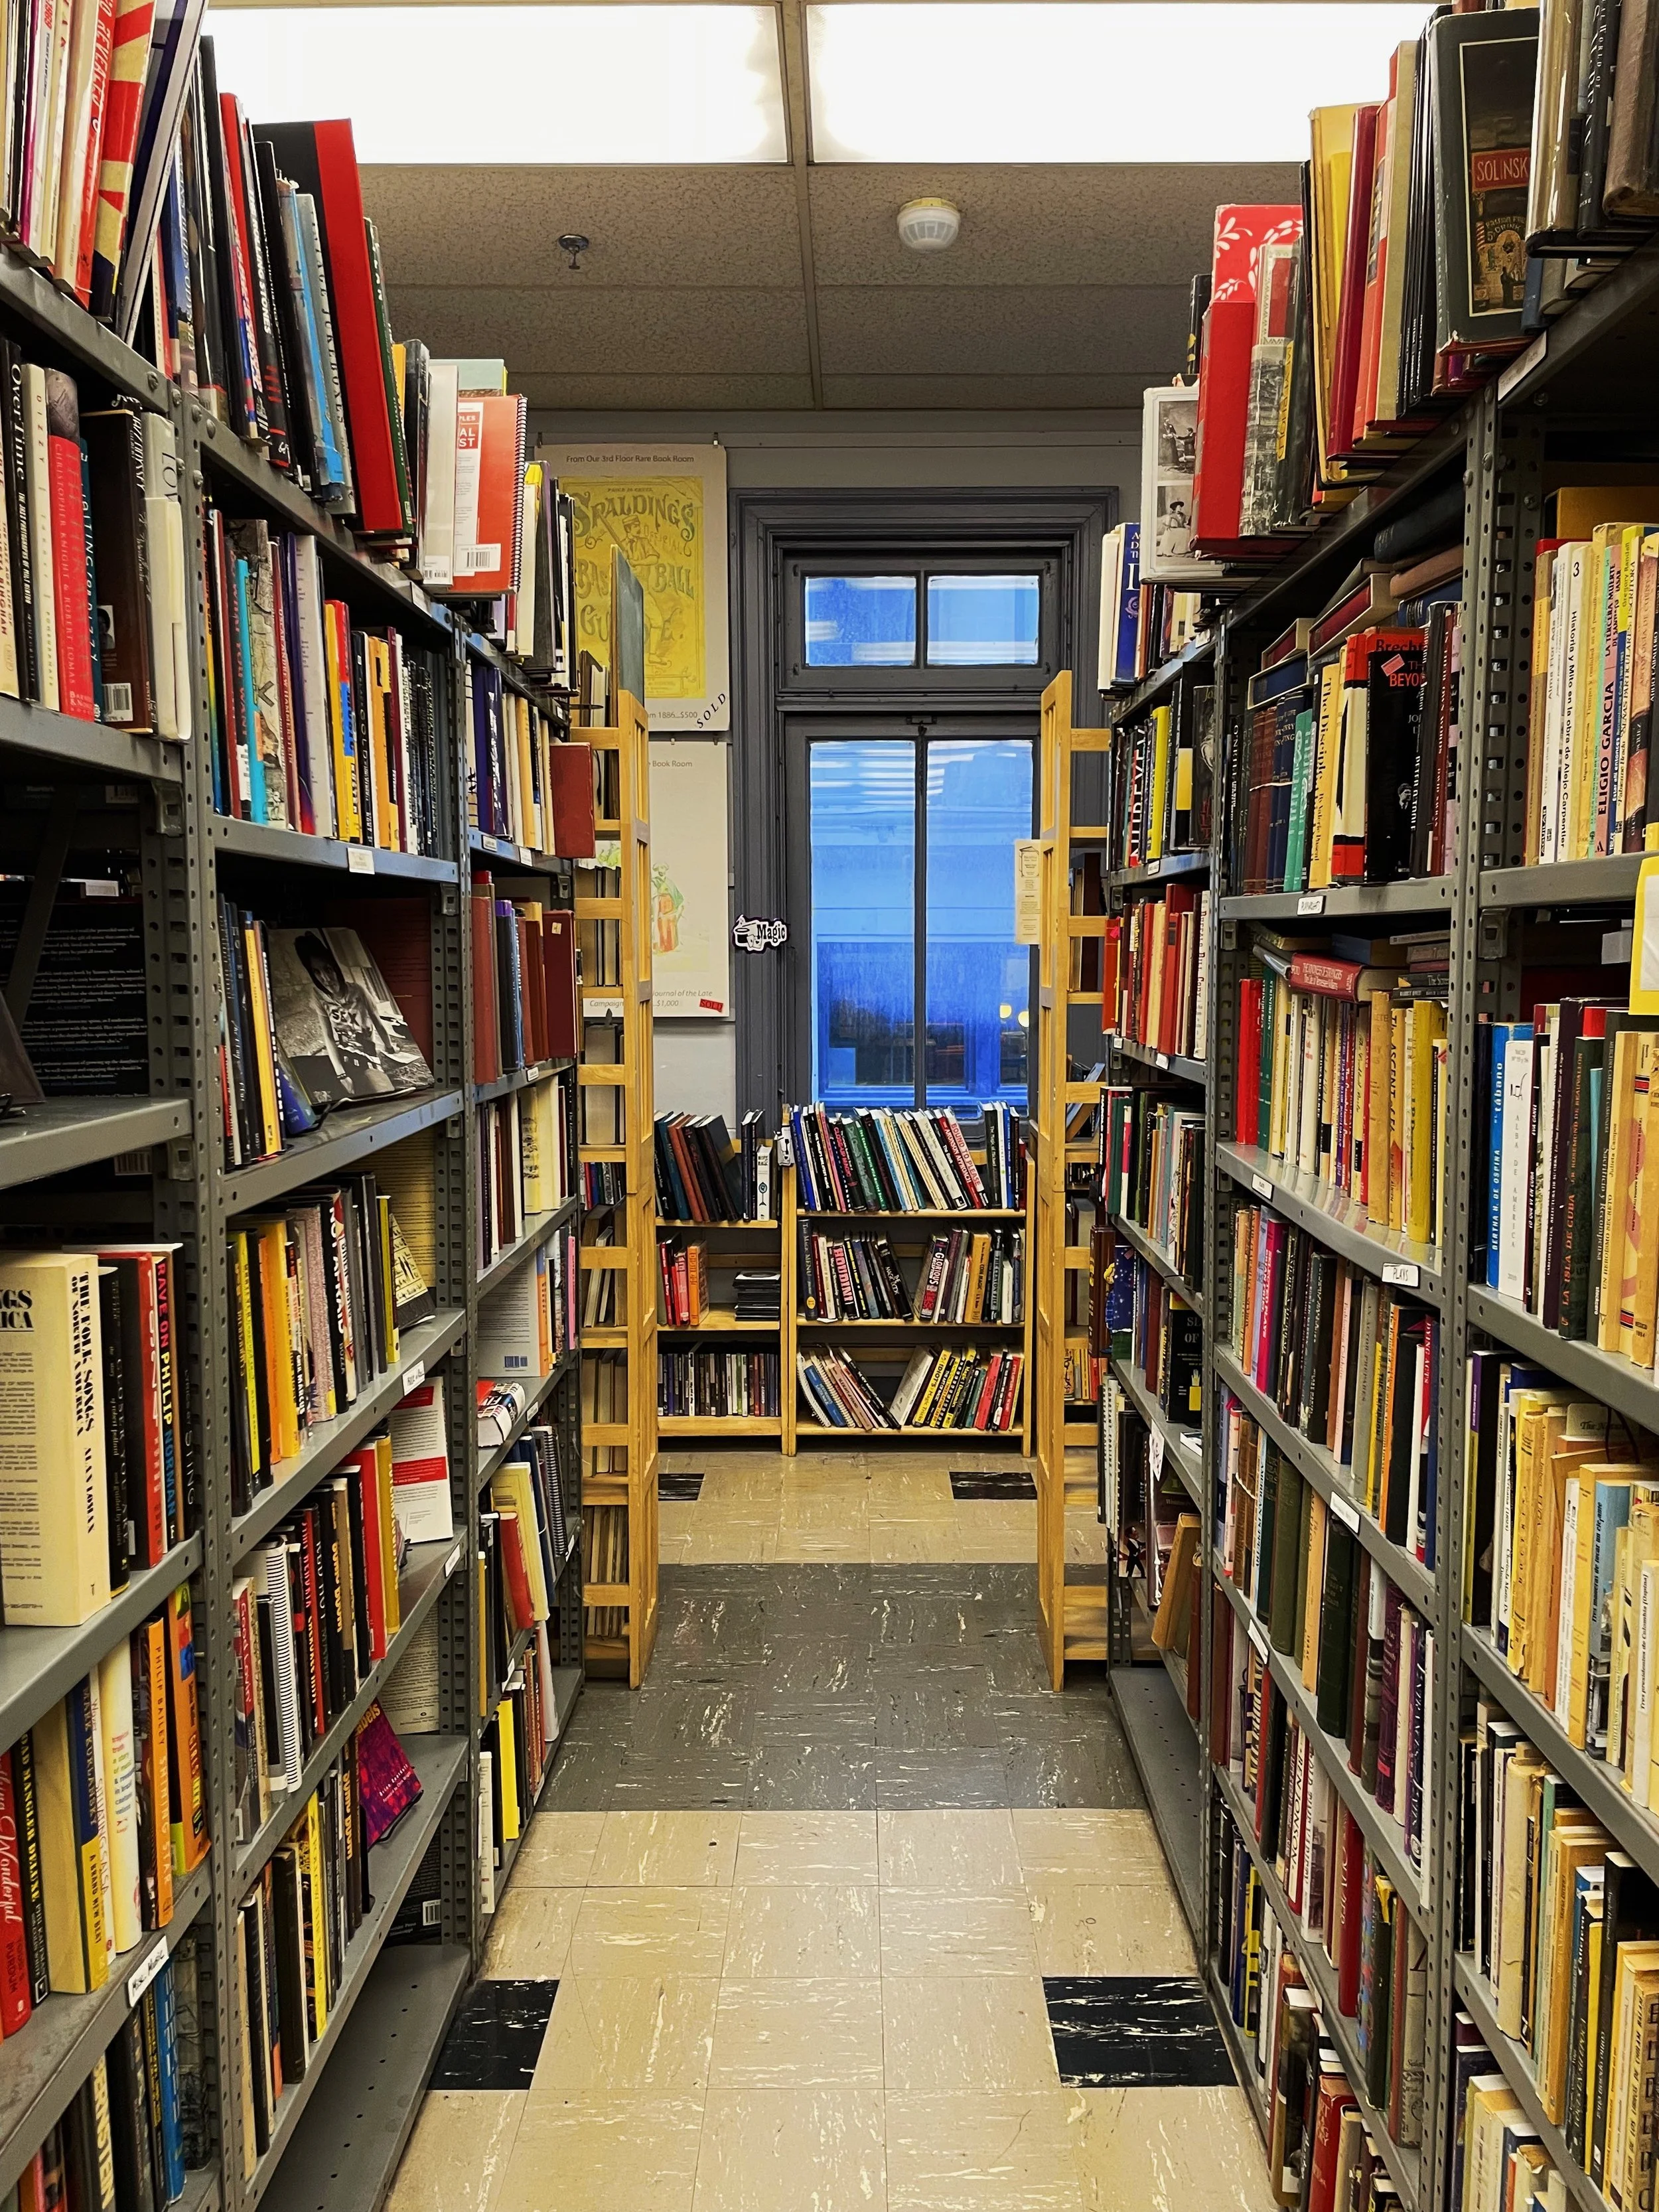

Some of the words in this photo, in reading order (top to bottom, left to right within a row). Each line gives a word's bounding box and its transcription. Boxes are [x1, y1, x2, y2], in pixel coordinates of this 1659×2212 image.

[1596, 25, 1607, 68] WORLD
[1595, 76, 1601, 89] OF
[1494, 223, 1520, 234] DRINK
[252, 220, 265, 279] ROLLING
[259, 281, 271, 334] STONES
[1277, 346, 1293, 461] MEYERHOLD
[54, 443, 66, 526] CHRISTOPHER
[61, 532, 70, 577] KNIGHT
[577, 557, 609, 599] BAS
[651, 563, 694, 601] BALL
[1571, 561, 1580, 577] 3
[1607, 562, 1616, 607] MUERTE
[1621, 575, 1630, 607] Gregory
[1569, 611, 1578, 650] Historia
[1605, 609, 1614, 644] TERCERA
[1605, 646, 1612, 656] LA
[696, 692, 727, 729] SOLD
[1322, 678, 1332, 712] The
[1566, 688, 1574, 701] en
[1564, 716, 1573, 739] obra
[1600, 681, 1615, 751] GARCIA
[1315, 715, 1329, 780] Disciple
[1563, 741, 1571, 755] de
[1561, 757, 1571, 790] Alejo
[1597, 756, 1611, 816] ELIGIO
[1559, 792, 1571, 848] Carpentier
[756, 924, 786, 944] Magic
[332, 1009, 360, 1027] SEX
[699, 999, 723, 1011] SOLD
[1575, 1052, 1583, 1106] BEAUVALLON
[1574, 1109, 1579, 1120] DE
[950, 1123, 967, 1145] BOUND
[833, 1127, 848, 1157] CLOSE-UP
[841, 1159, 851, 1177] MAGIC
[961, 1147, 971, 1159] TO
[964, 1161, 981, 1187] PLEASE
[1566, 1194, 1575, 1228] CUBA
[1565, 1230, 1573, 1249] DE
[71, 1276, 78, 1295] OF
[833, 1248, 853, 1302] HOUDINI
[928, 1252, 945, 1285] GLORIOUS
[929, 1257, 938, 1280] DECEPTION
[1393, 1267, 1409, 1282] PLAYS
[1563, 1255, 1572, 1283] ISLA
[78, 1272, 91, 1312] THE
[157, 1263, 169, 1317] RAVE
[1562, 1290, 1570, 1305] LA
[1366, 1303, 1372, 1320] AN
[80, 1315, 93, 1364] FOLK
[159, 1320, 171, 1348] ON
[1184, 1332, 1199, 1343] OF
[161, 1351, 173, 1425] PHILIP
[930, 1364, 946, 1388] IDIOT'S
[960, 1366, 971, 1380] Magic
[74, 1360, 84, 1437] AMERICA
[83, 1369, 96, 1432] SONGS
[922, 1390, 934, 1406] Magic
[952, 1384, 965, 1408] Dummies
[917, 1406, 928, 1422] Tricks
[1375, 1392, 1384, 1437] ANTIPHON
[84, 1447, 93, 1483] ALAN
[163, 1429, 176, 1516] NORMAN
[85, 1485, 95, 1535] LOMAX
[240, 1602, 249, 1648] Good
[1641, 1641, 1646, 1650] de
[243, 1654, 253, 1704] Lovin'
[83, 1686, 93, 1724] MARK
[19, 1733, 31, 1765] OAD
[190, 1733, 200, 1777] GIRLS
[84, 1726, 98, 1826] KURLANSKY
[1295, 1754, 1304, 1789] BEN
[21, 1769, 36, 1838] MANGLER
[159, 1755, 169, 1834] SHINING
[193, 1809, 204, 1836] US
[1291, 1793, 1302, 1865] JONSON
[0, 1816, 21, 1925] Wonderful
[27, 1843, 40, 1903] DELUXE
[90, 1864, 100, 1895] BRAND
[163, 1842, 171, 1885] STAR
[1632, 2068, 1638, 2079] DE
[1628, 2142, 1634, 2152] DE
[1626, 2187, 1632, 2196] EL
